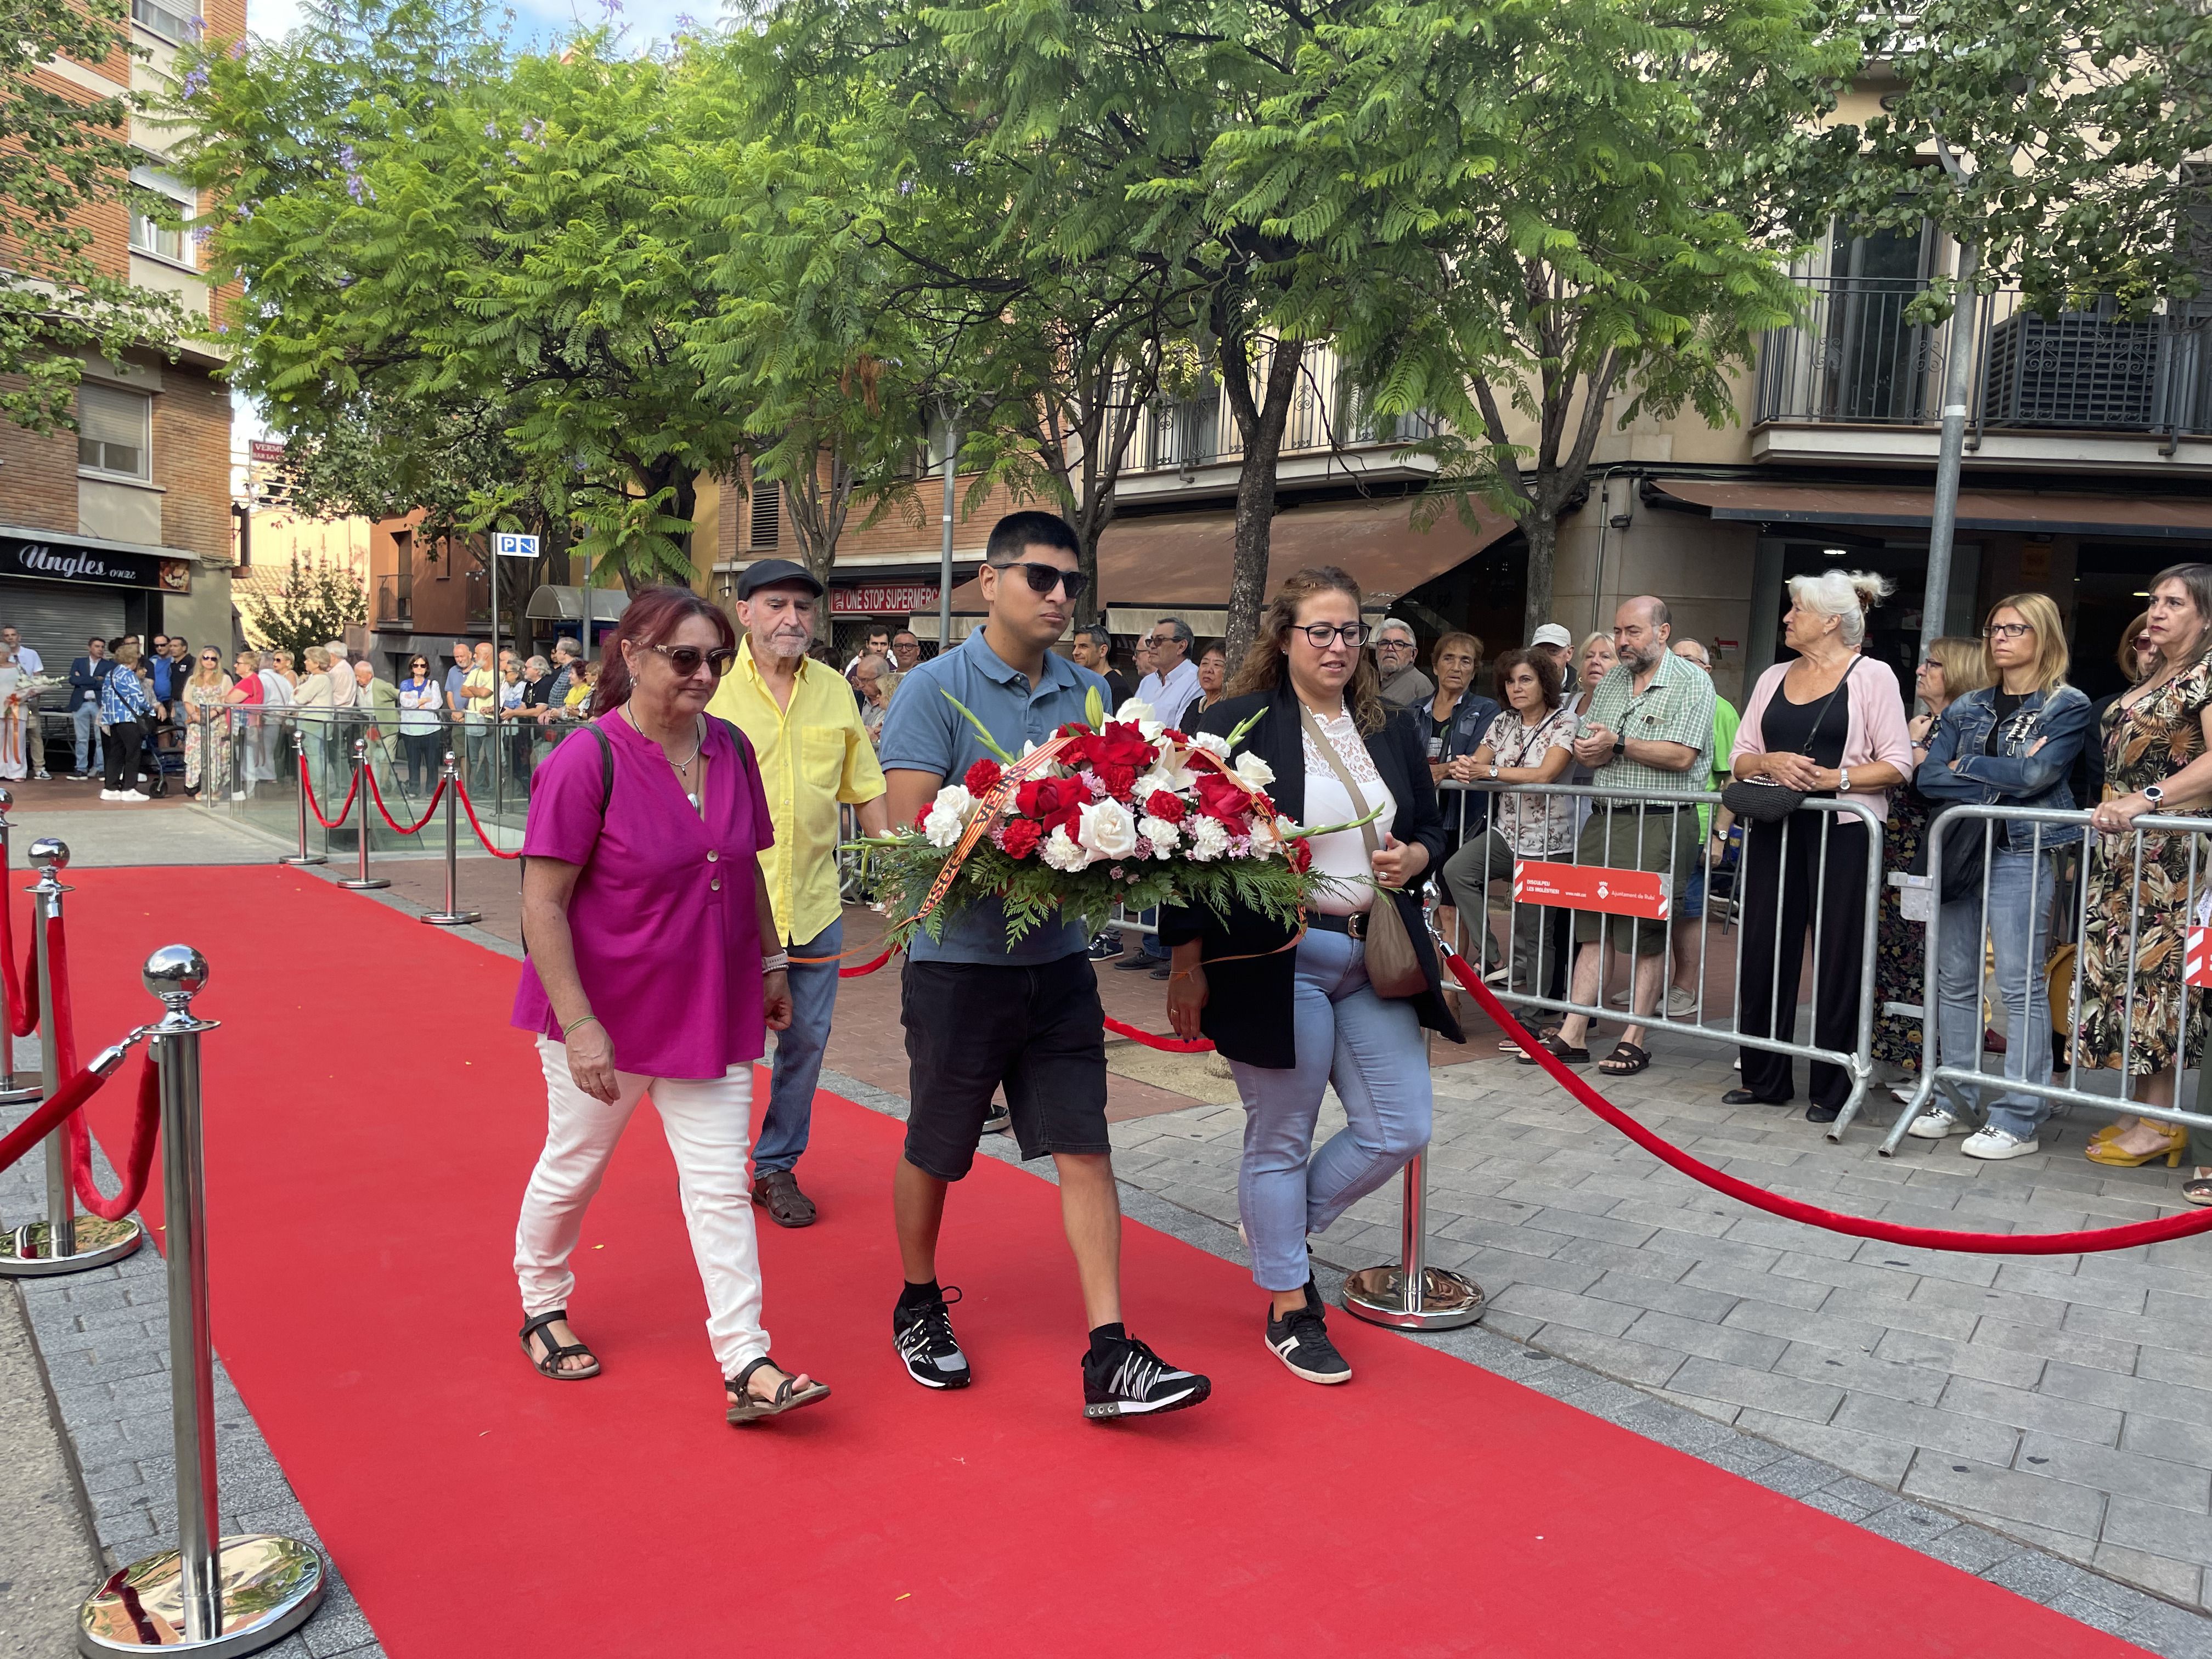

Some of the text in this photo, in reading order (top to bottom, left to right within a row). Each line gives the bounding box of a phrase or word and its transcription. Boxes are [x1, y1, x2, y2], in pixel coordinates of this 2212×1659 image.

[255, 443, 285, 453] VERMU
[504, 538, 515, 551] P
[846, 587, 941, 610] ONE STOP SUPERMERC
[975, 766, 1028, 824] VEINS
[1611, 890, 1637, 898] Ajuntament
